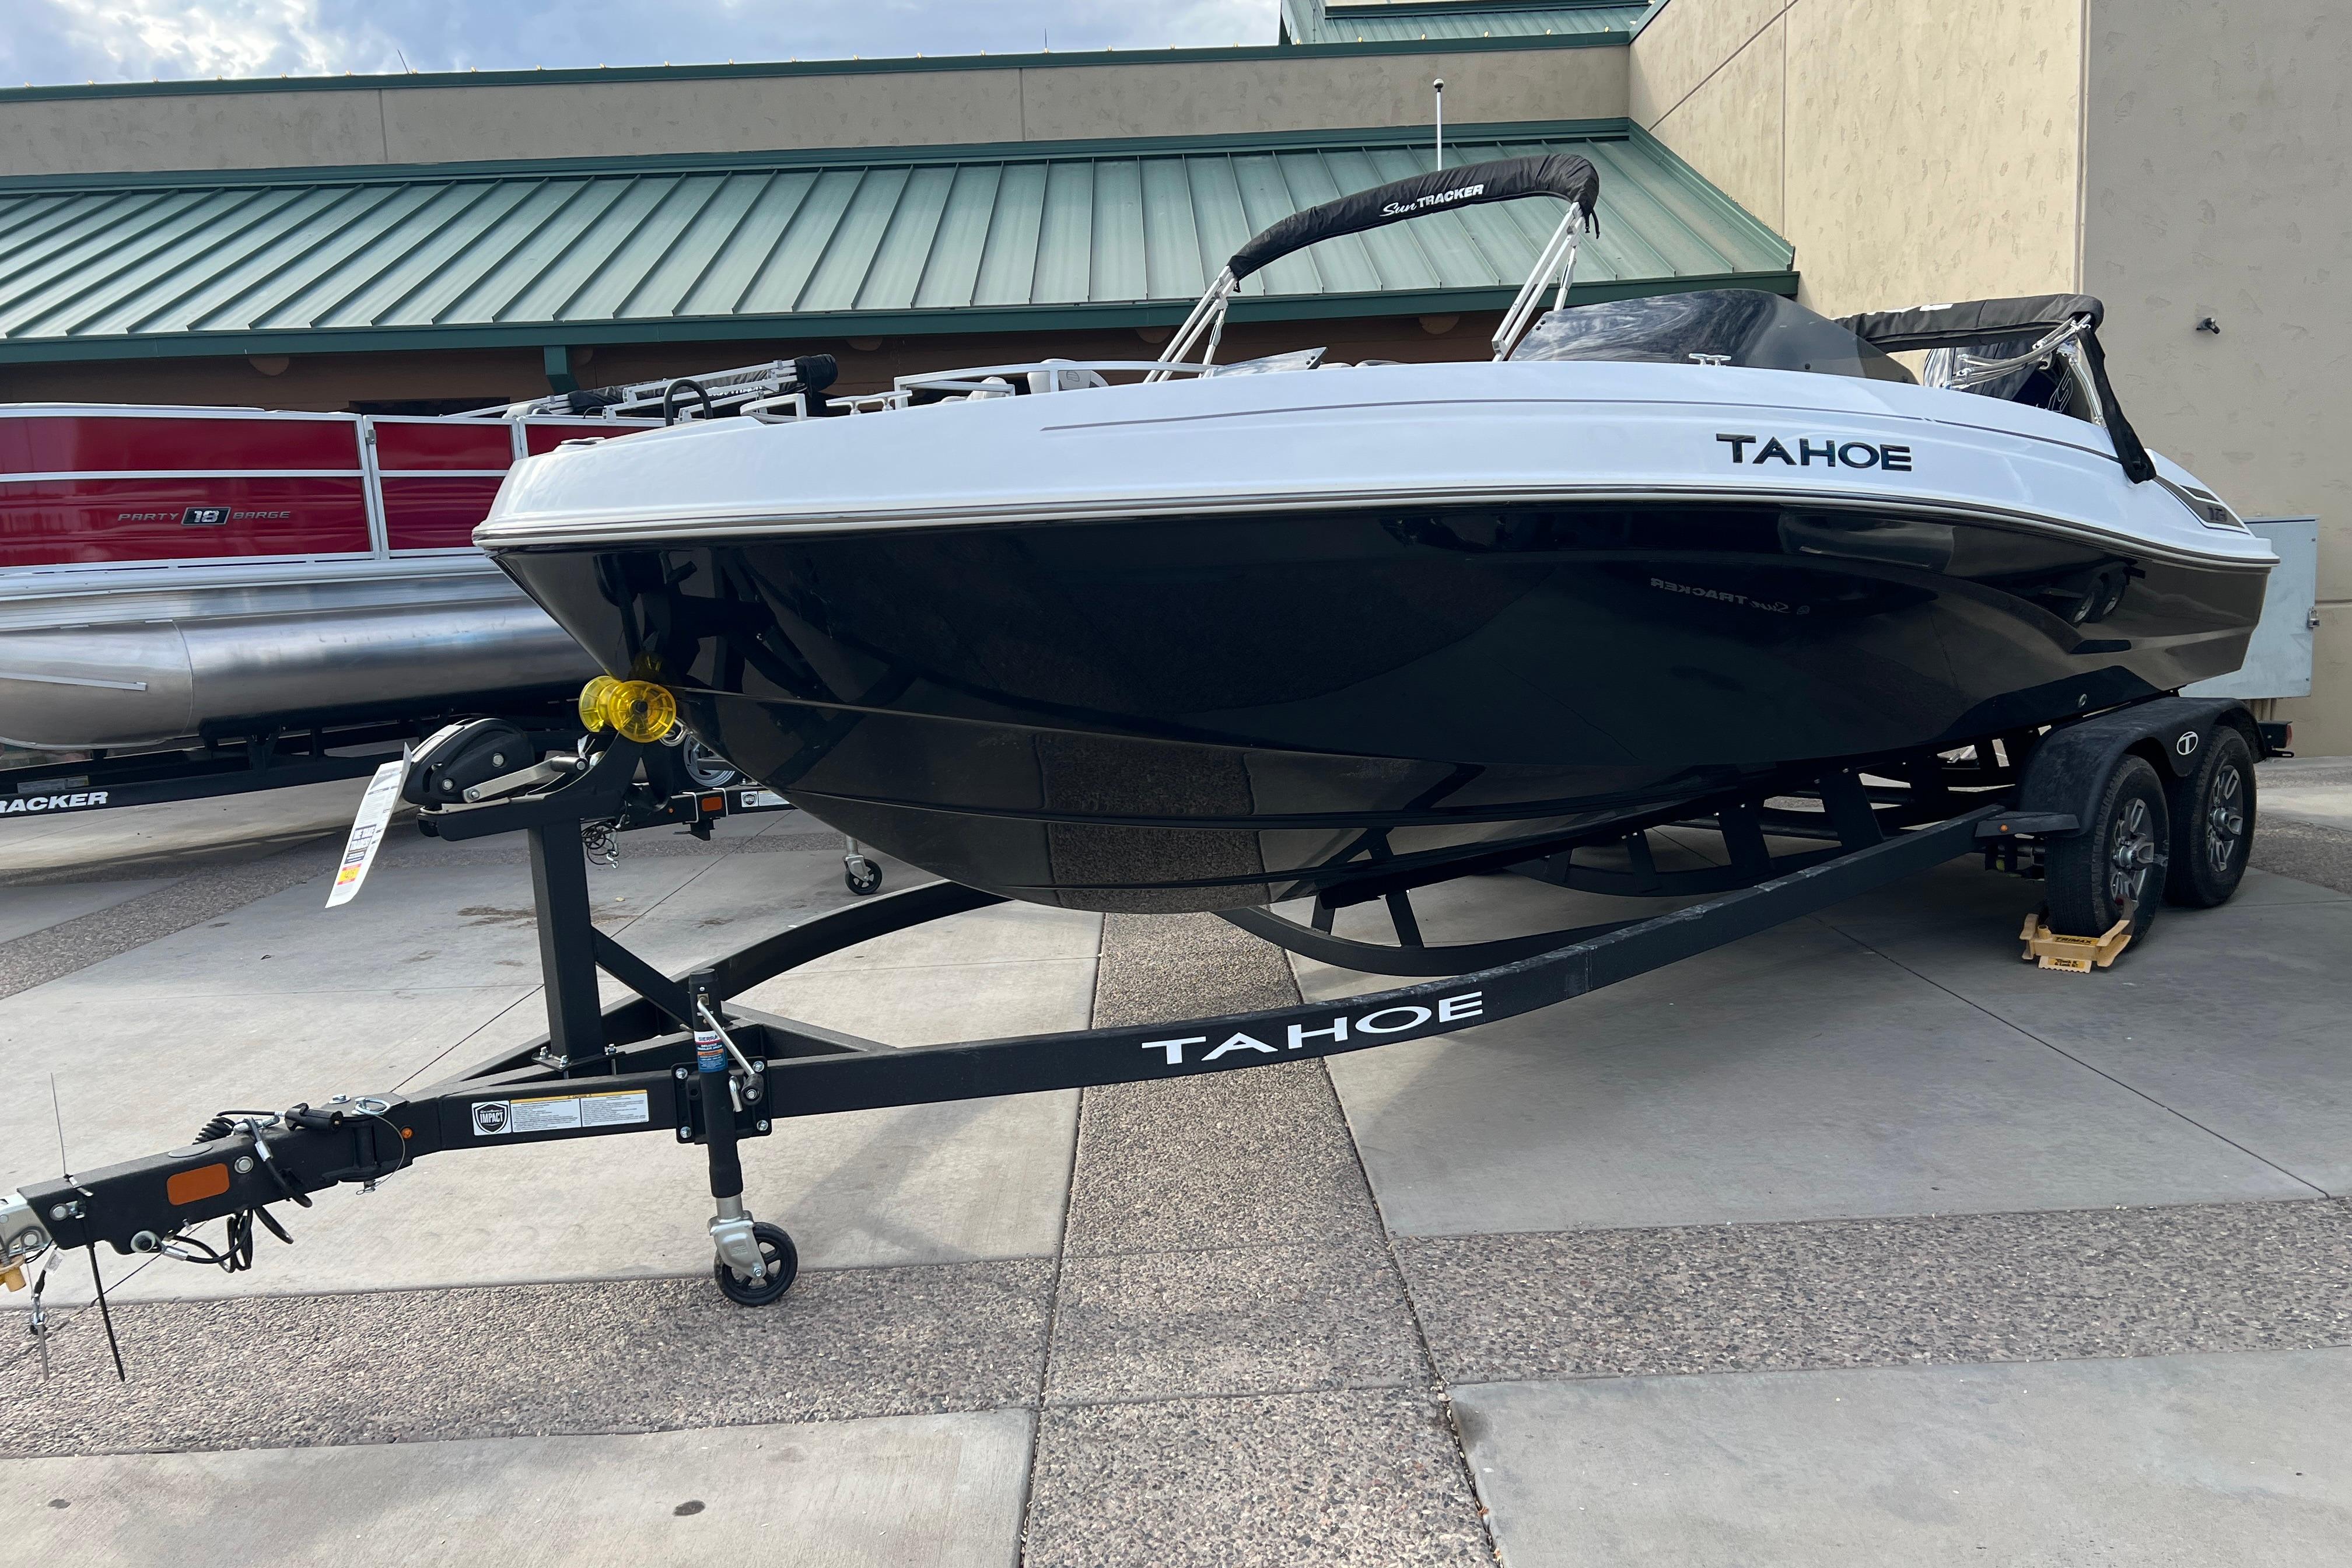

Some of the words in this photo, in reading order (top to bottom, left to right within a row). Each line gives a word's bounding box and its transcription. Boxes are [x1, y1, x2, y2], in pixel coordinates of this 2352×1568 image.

[1379, 202, 1418, 217] Sun
[1417, 184, 1485, 208] TRACKER
[1716, 433, 1912, 472] TAHOE
[118, 513, 180, 522] PARTY
[194, 510, 220, 523] 18
[233, 511, 290, 520] BARGE
[0, 791, 108, 814] ACKER
[1141, 991, 1483, 1065] TAHOE
[480, 1112, 503, 1124] IMPACT
